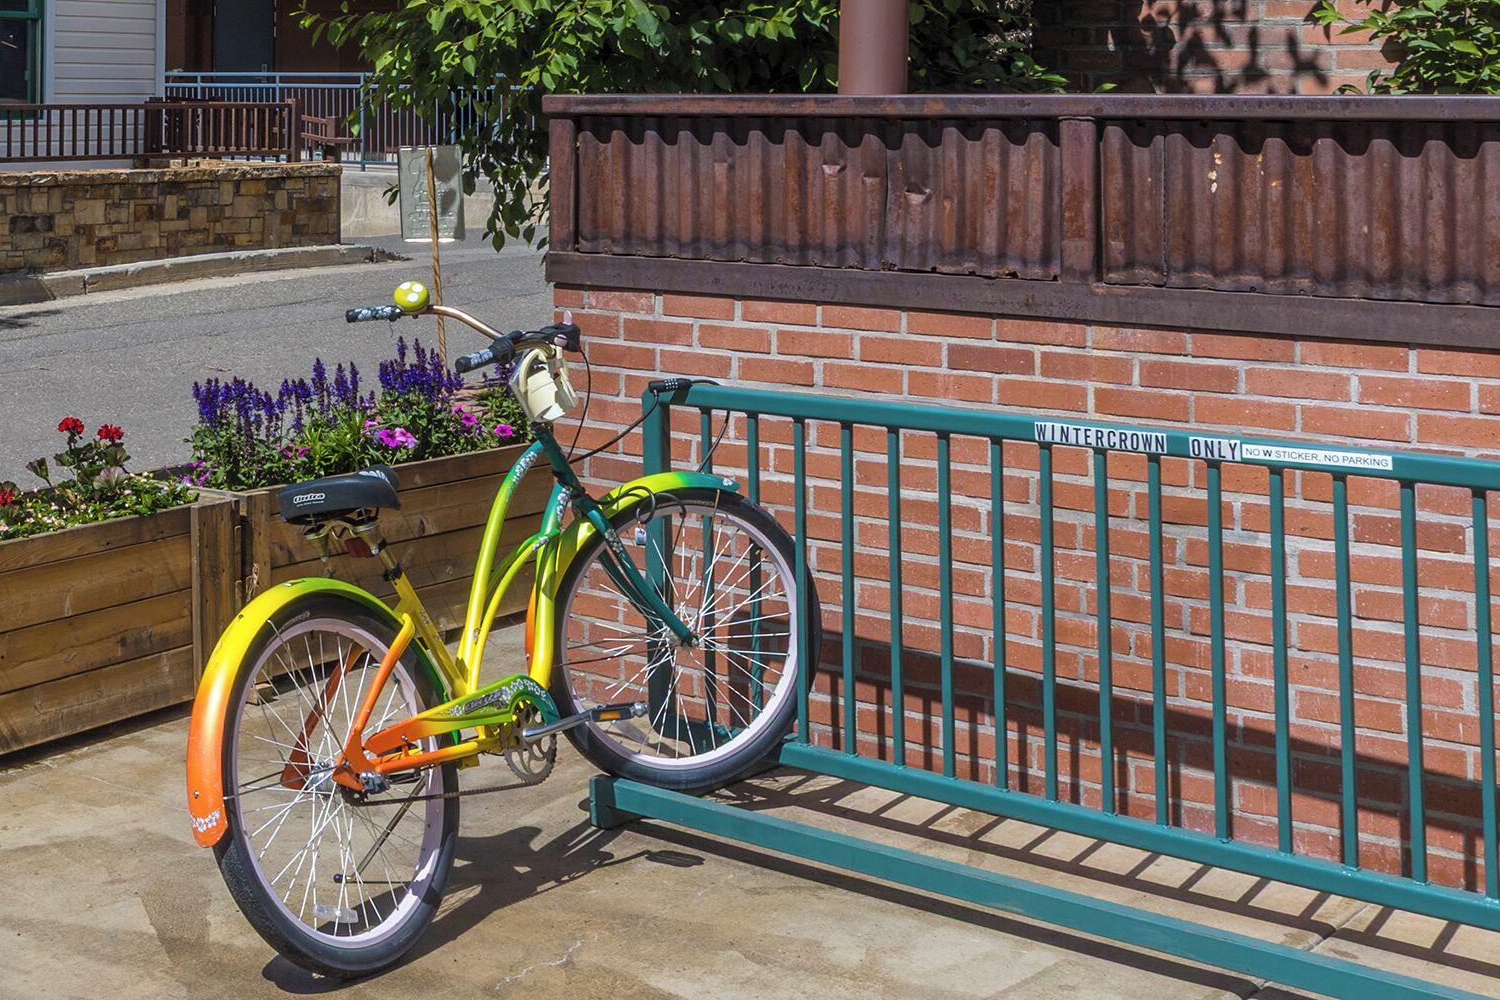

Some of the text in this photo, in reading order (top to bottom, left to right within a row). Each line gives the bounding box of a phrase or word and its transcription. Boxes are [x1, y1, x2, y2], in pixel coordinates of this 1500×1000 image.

[1035, 423, 1239, 460] WINTERCROWN ONLY
[1245, 448, 1260, 457] NO
[1262, 449, 1273, 457] W
[1324, 454, 1340, 463] NO
[1342, 455, 1390, 467] PARKING
